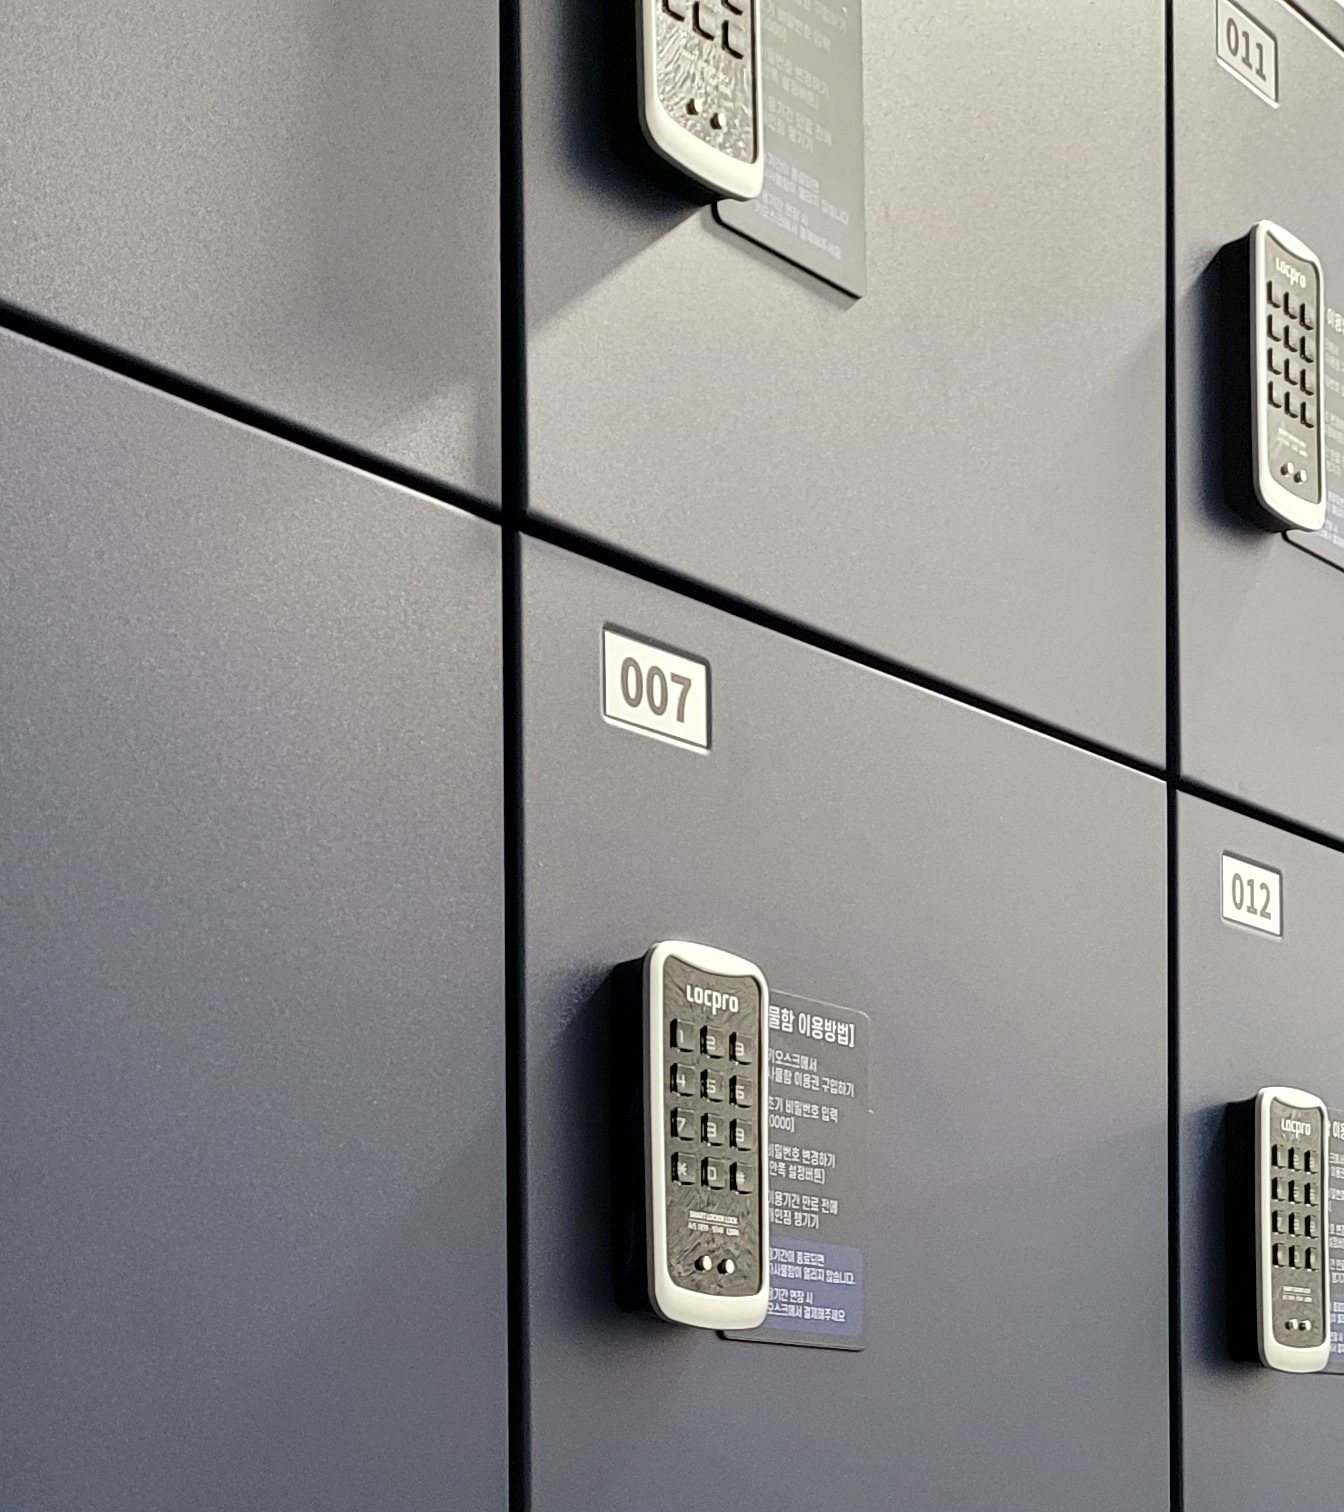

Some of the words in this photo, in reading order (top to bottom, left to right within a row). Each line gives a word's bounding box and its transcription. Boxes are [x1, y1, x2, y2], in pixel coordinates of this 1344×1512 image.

[1225, 17, 1267, 81] 011
[620, 656, 692, 723] 007
[1231, 872, 1271, 920] 012
[798, 1013, 854, 1047] 이용방법]
